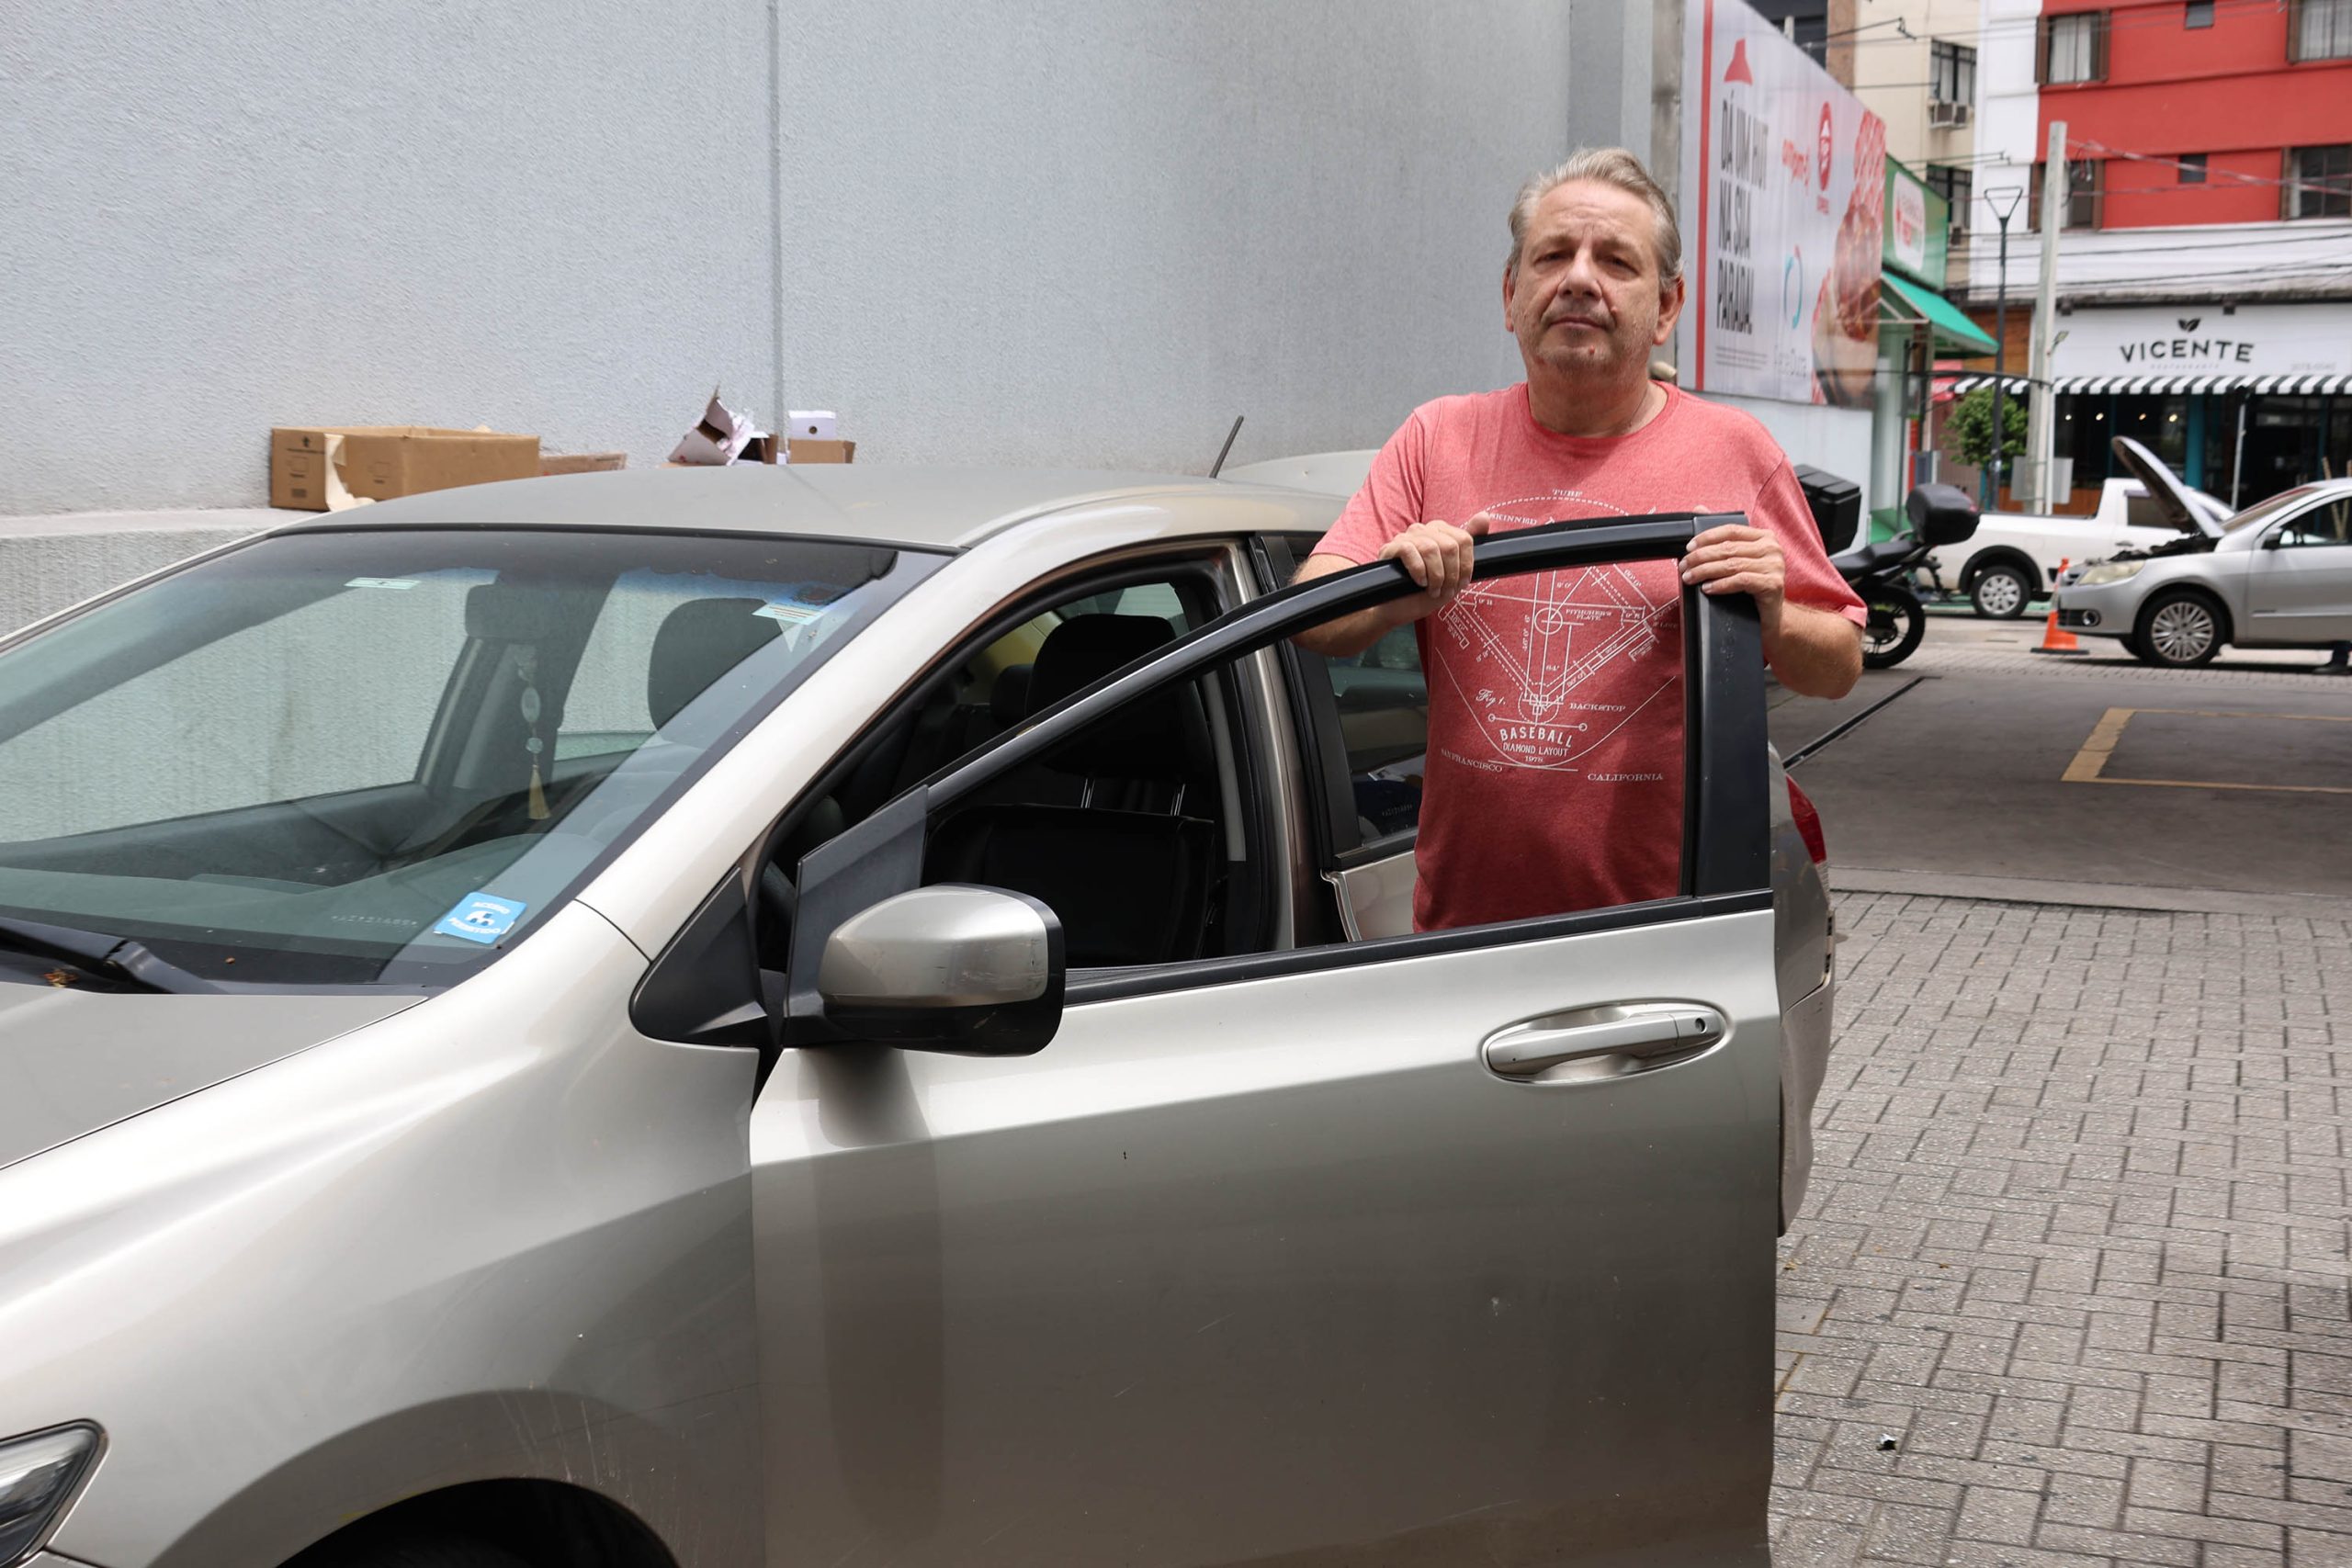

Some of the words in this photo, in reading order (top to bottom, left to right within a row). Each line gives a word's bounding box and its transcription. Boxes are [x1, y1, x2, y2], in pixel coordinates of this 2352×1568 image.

[1721, 89, 1735, 175] DÁ
[1719, 179, 1732, 252] NA
[2120, 339, 2255, 363] VICENTE
[1476, 688, 1497, 708] Fig
[1569, 702, 1627, 712] BACKSTOP
[1499, 727, 1573, 748] BASEBALL
[1502, 742, 1536, 755] DIAMOND
[1538, 745, 1569, 757] LAYOUT
[1452, 752, 1503, 773] FRANCISCO
[1588, 773, 1664, 782] CALIFORNIA
